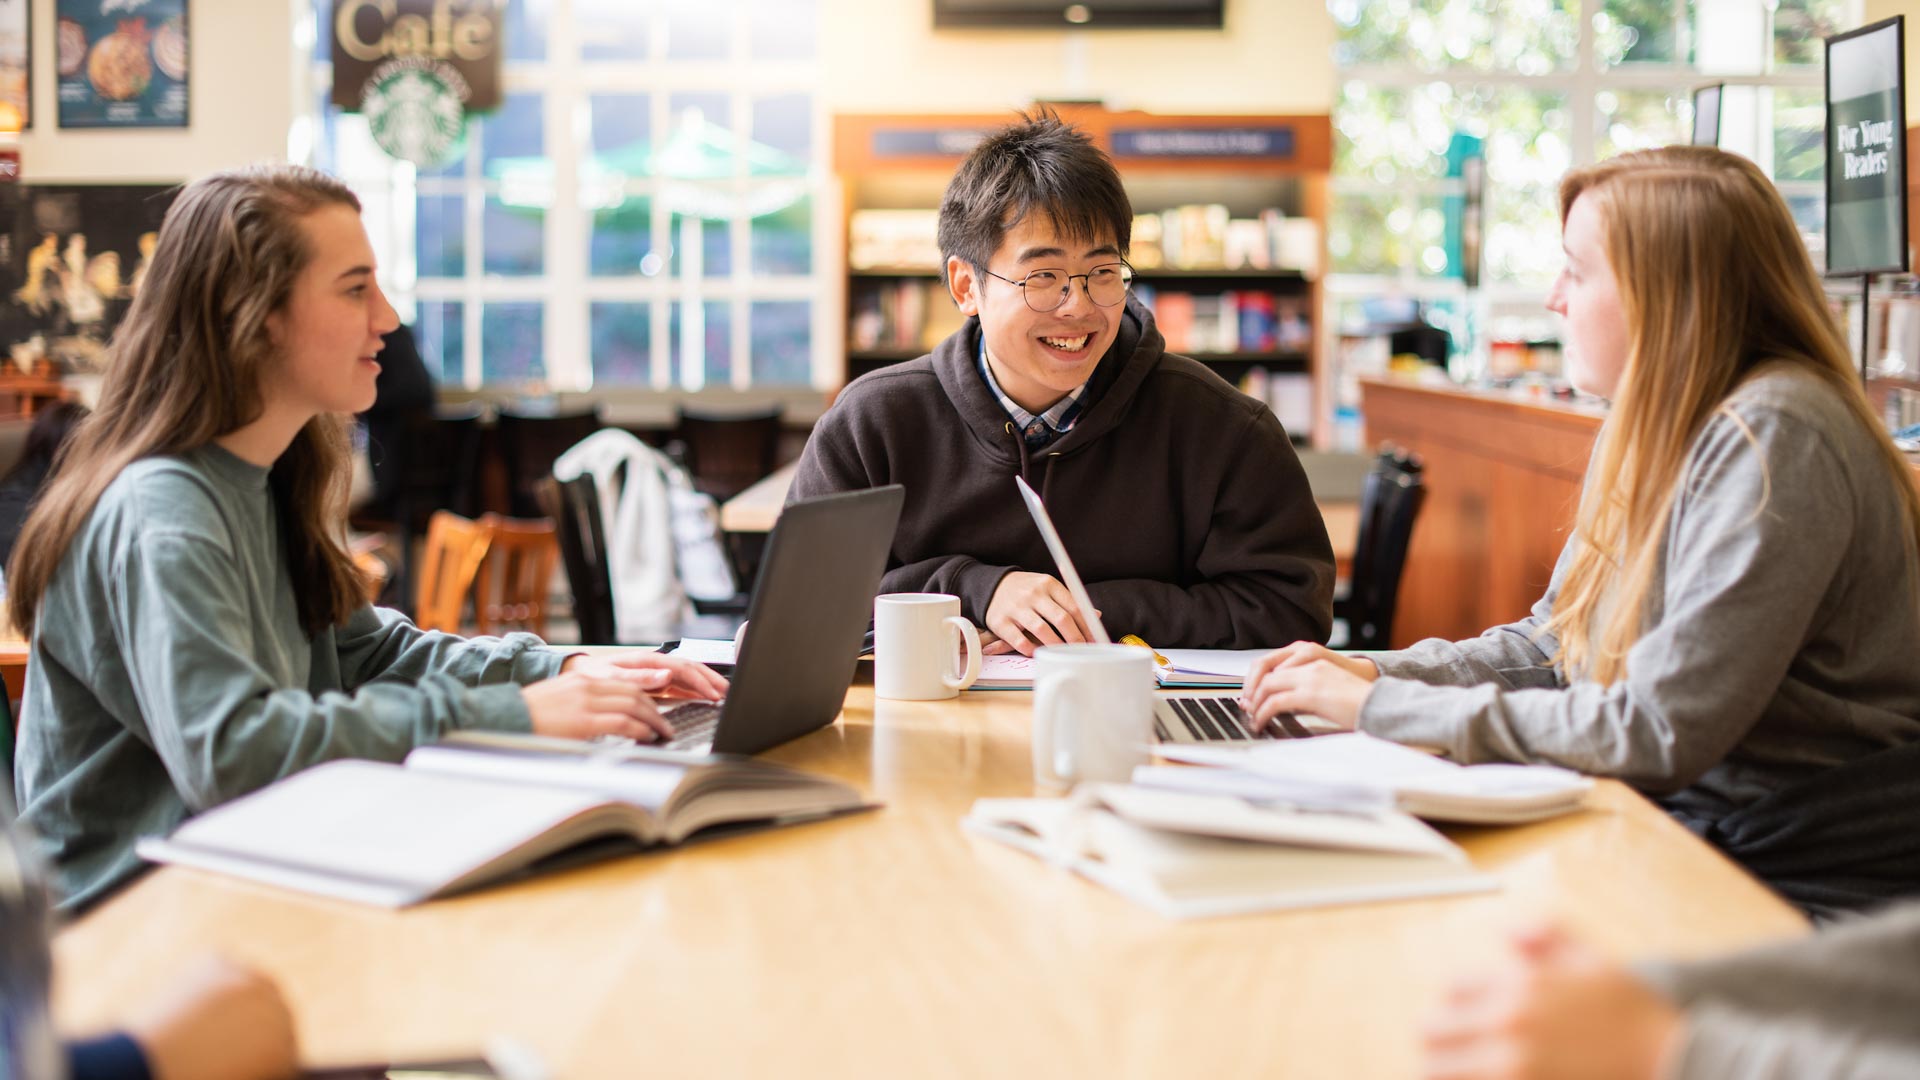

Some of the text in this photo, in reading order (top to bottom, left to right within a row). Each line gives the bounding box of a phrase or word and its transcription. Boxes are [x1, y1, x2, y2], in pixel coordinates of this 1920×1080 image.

[1838, 120, 1893, 152] For Young
[1844, 149, 1888, 179] Readers
